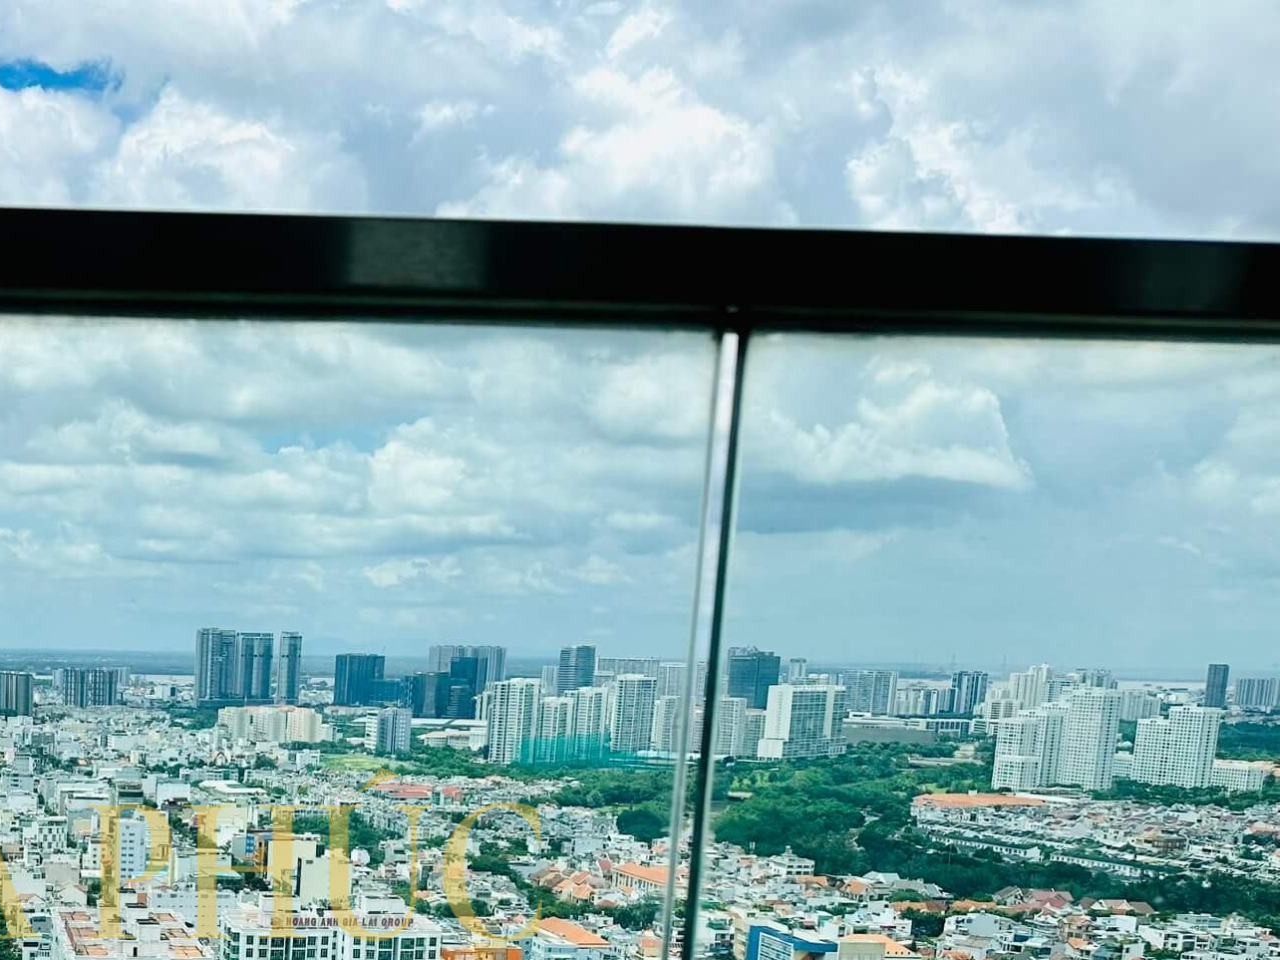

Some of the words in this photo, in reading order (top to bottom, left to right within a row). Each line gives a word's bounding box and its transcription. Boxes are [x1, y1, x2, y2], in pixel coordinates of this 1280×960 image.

[320, 917, 339, 927] ANH
[361, 917, 378, 927] LAI
[381, 917, 414, 927] GROUP
